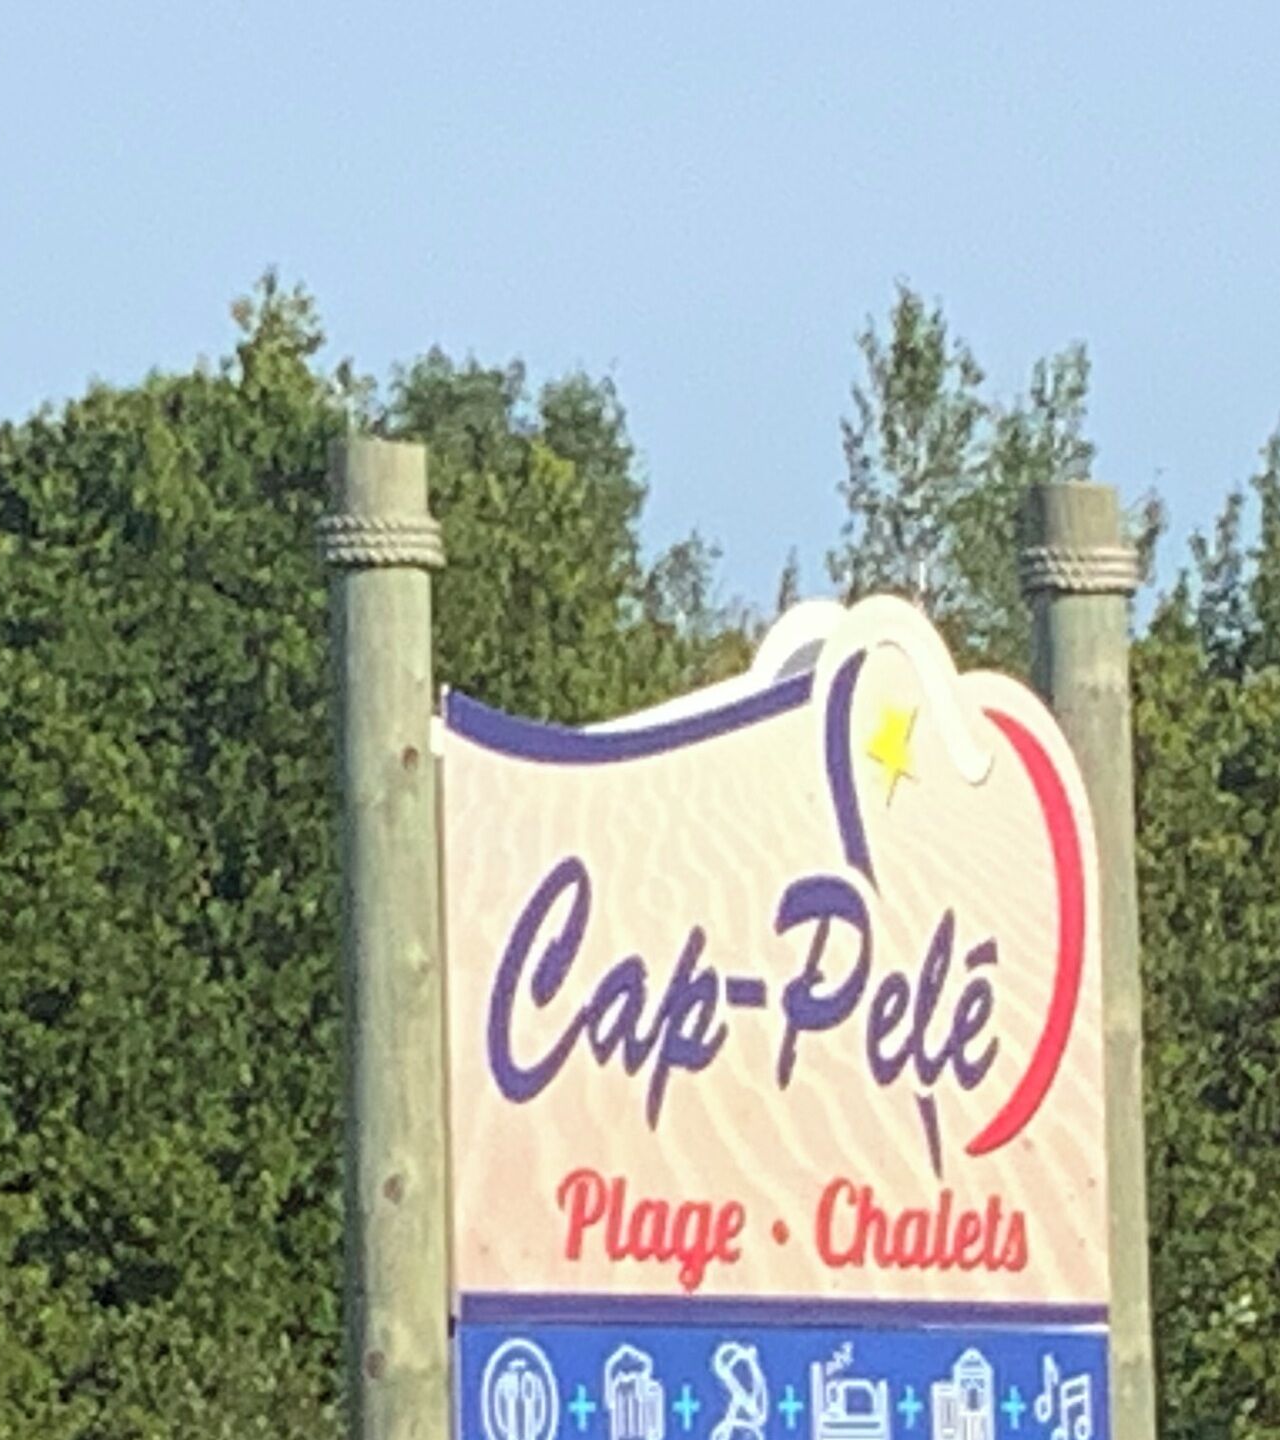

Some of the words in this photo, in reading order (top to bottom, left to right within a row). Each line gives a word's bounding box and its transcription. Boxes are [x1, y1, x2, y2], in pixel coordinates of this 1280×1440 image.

[486, 855, 1000, 1131] Cap-Pelé
[557, 1168, 746, 1294] Plage
[814, 1177, 1029, 1273] Chalets
